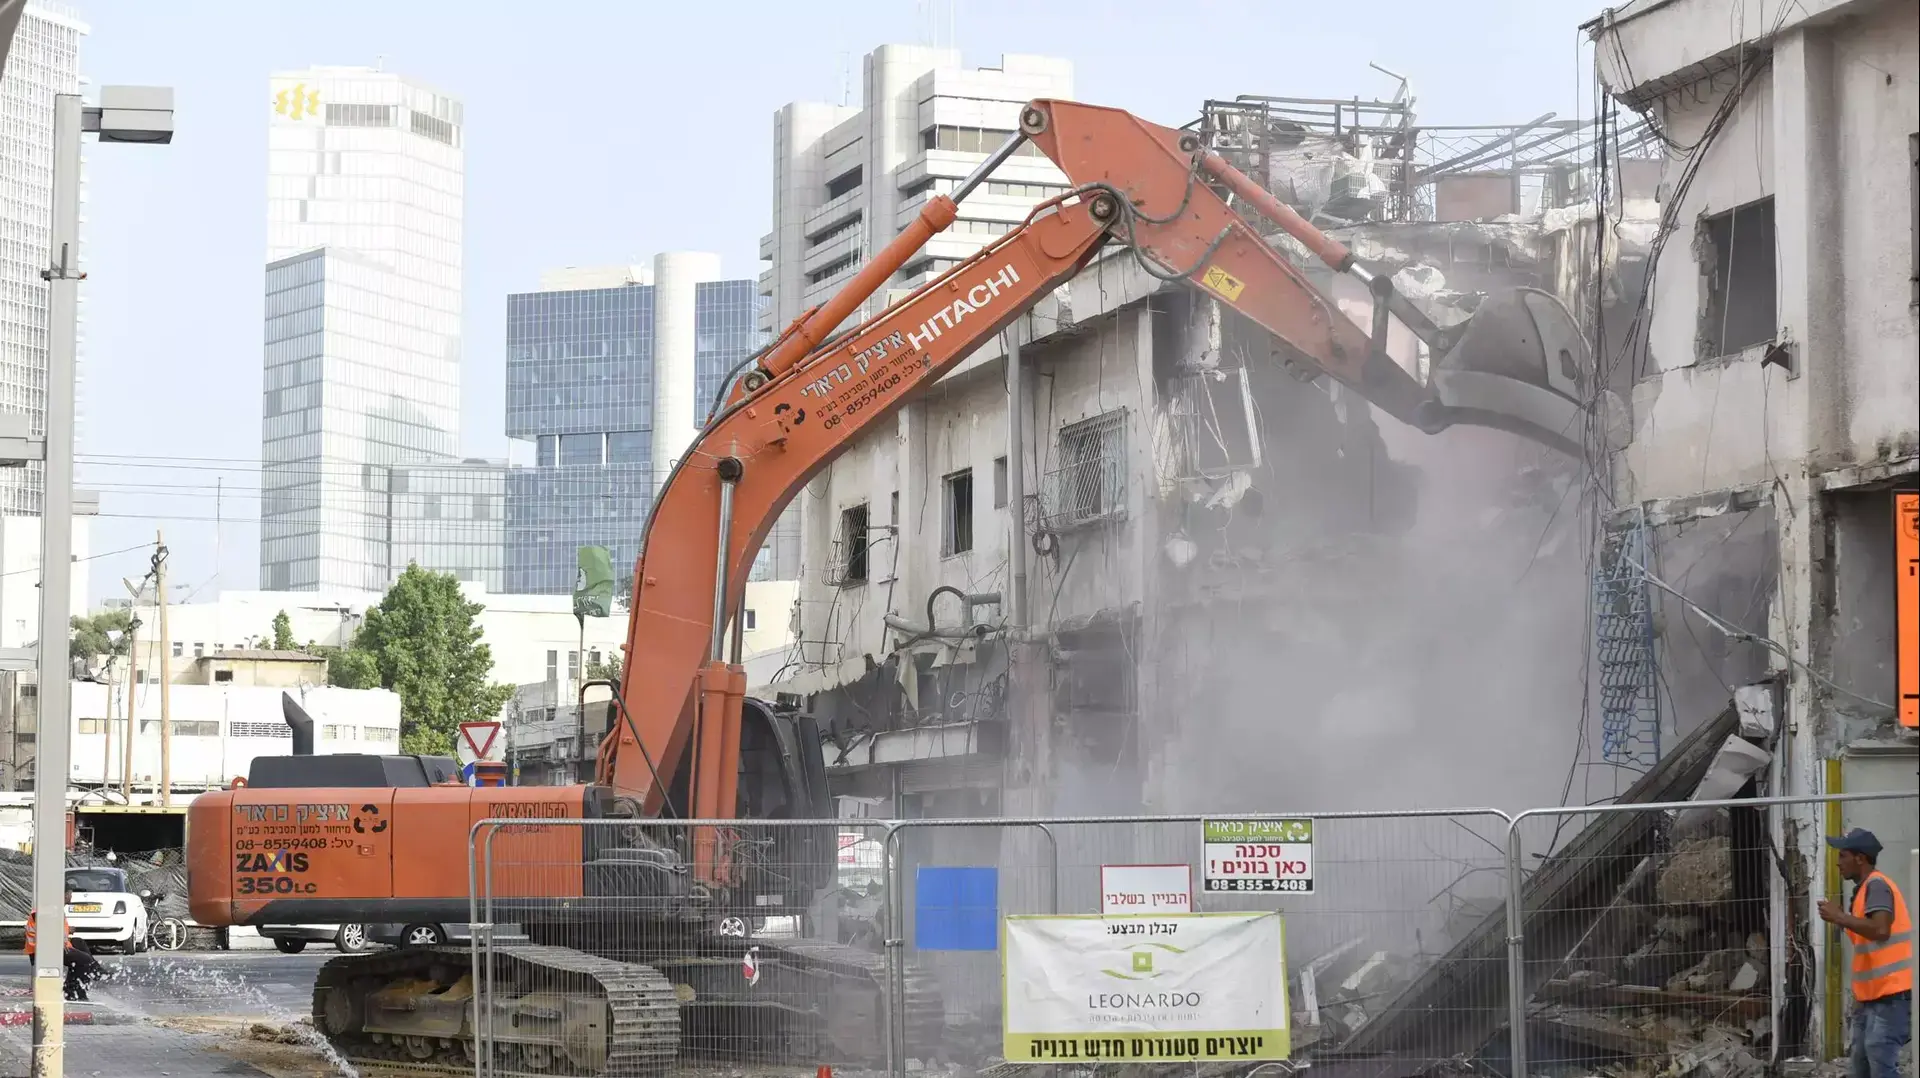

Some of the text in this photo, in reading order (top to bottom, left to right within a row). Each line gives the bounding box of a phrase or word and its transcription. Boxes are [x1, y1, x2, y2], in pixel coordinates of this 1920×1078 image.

[907, 263, 1020, 351] HITACHI
[853, 330, 905, 376] איציק
[869, 367, 889, 384] למען
[838, 380, 869, 404] הסביבה
[824, 373, 901, 430] 08-8559408
[296, 803, 350, 825] איציק
[263, 825, 296, 834] הסביבה
[300, 823, 320, 835] למען
[324, 825, 351, 834] מיחזור
[1209, 821, 1283, 835] איציק כראדי
[236, 837, 354, 850] טל: 08-8559408
[1235, 845, 1281, 858] סכנה
[236, 848, 309, 872] ZAXIS
[1223, 860, 1269, 874] בונים
[1275, 861, 1307, 878] כאן
[1211, 880, 1307, 890] 08-855-9408
[1106, 892, 1187, 906] הבניין בשלבי
[1107, 922, 1178, 935] קבלן מבצע:
[1089, 992, 1200, 1009] LEONARDO
[1030, 1036, 1264, 1058] יוצרים סטנדרט חדש בבניה
